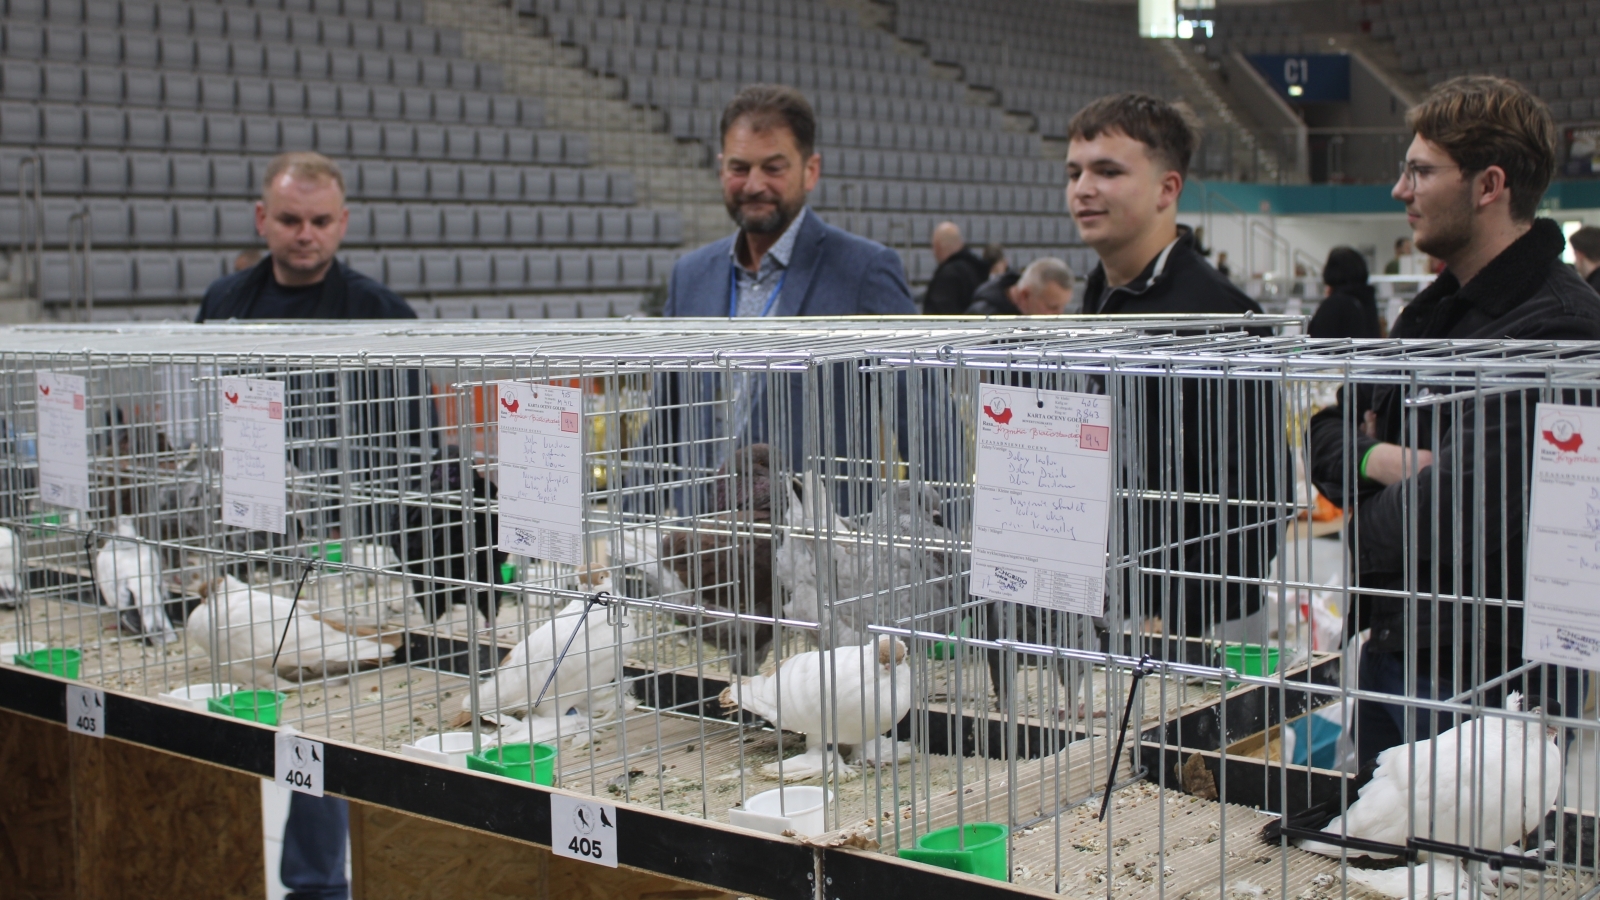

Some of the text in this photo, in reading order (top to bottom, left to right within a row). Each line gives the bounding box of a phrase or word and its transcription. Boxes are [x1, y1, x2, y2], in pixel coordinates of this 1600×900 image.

[1284, 58, 1308, 84] C1
[1082, 398, 1098, 408] 406
[1086, 434, 1100, 447] 94
[76, 716, 96, 732] 403
[285, 769, 312, 789] 404
[568, 836, 602, 858] 405
